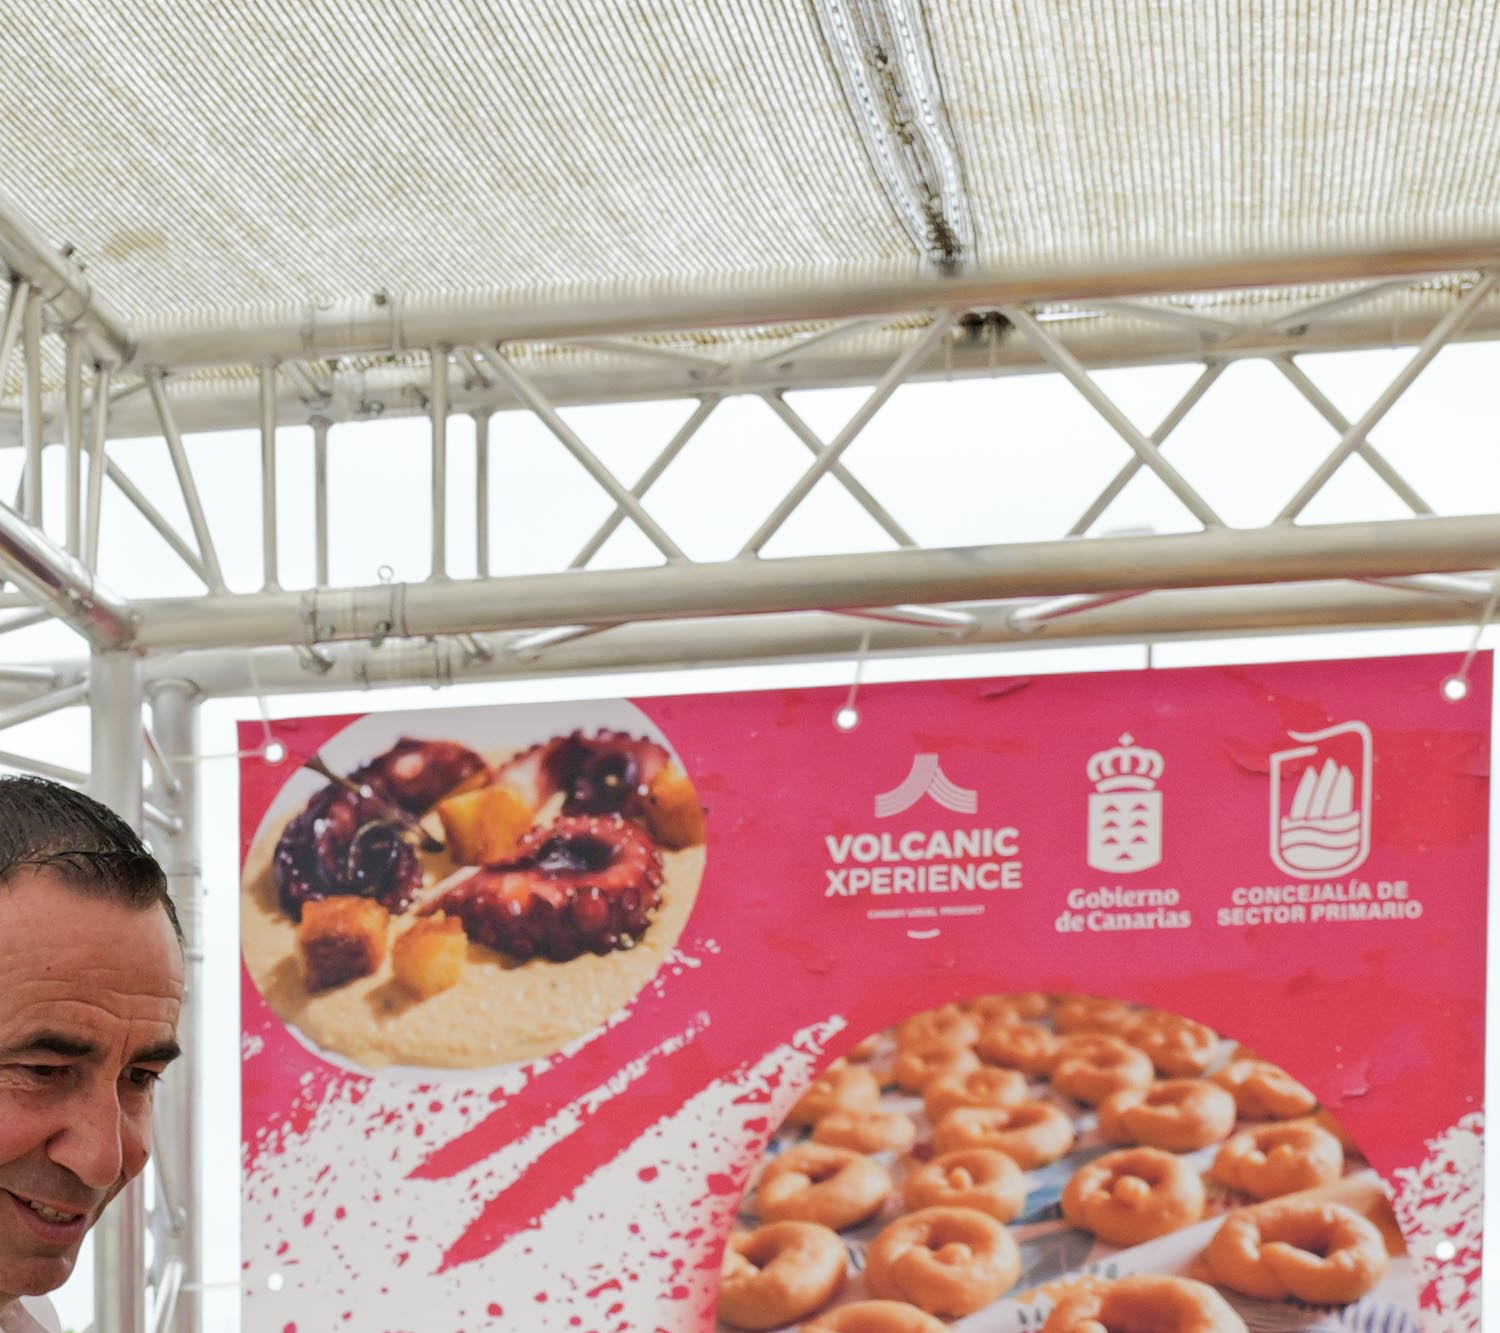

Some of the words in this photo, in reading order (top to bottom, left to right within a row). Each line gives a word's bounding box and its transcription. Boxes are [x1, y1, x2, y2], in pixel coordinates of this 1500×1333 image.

[825, 827, 1020, 864] VOLCANIC
[825, 861, 1023, 897] XPERIENCE
[1067, 886, 1180, 909] Gobierno
[1231, 879, 1372, 906] CONCEJALÍA
[1377, 881, 1409, 900] DE
[1055, 911, 1085, 933] de
[1087, 907, 1192, 931] Canarias
[1217, 904, 1306, 926] SECTOR
[1311, 900, 1423, 922] PRIMARIO
